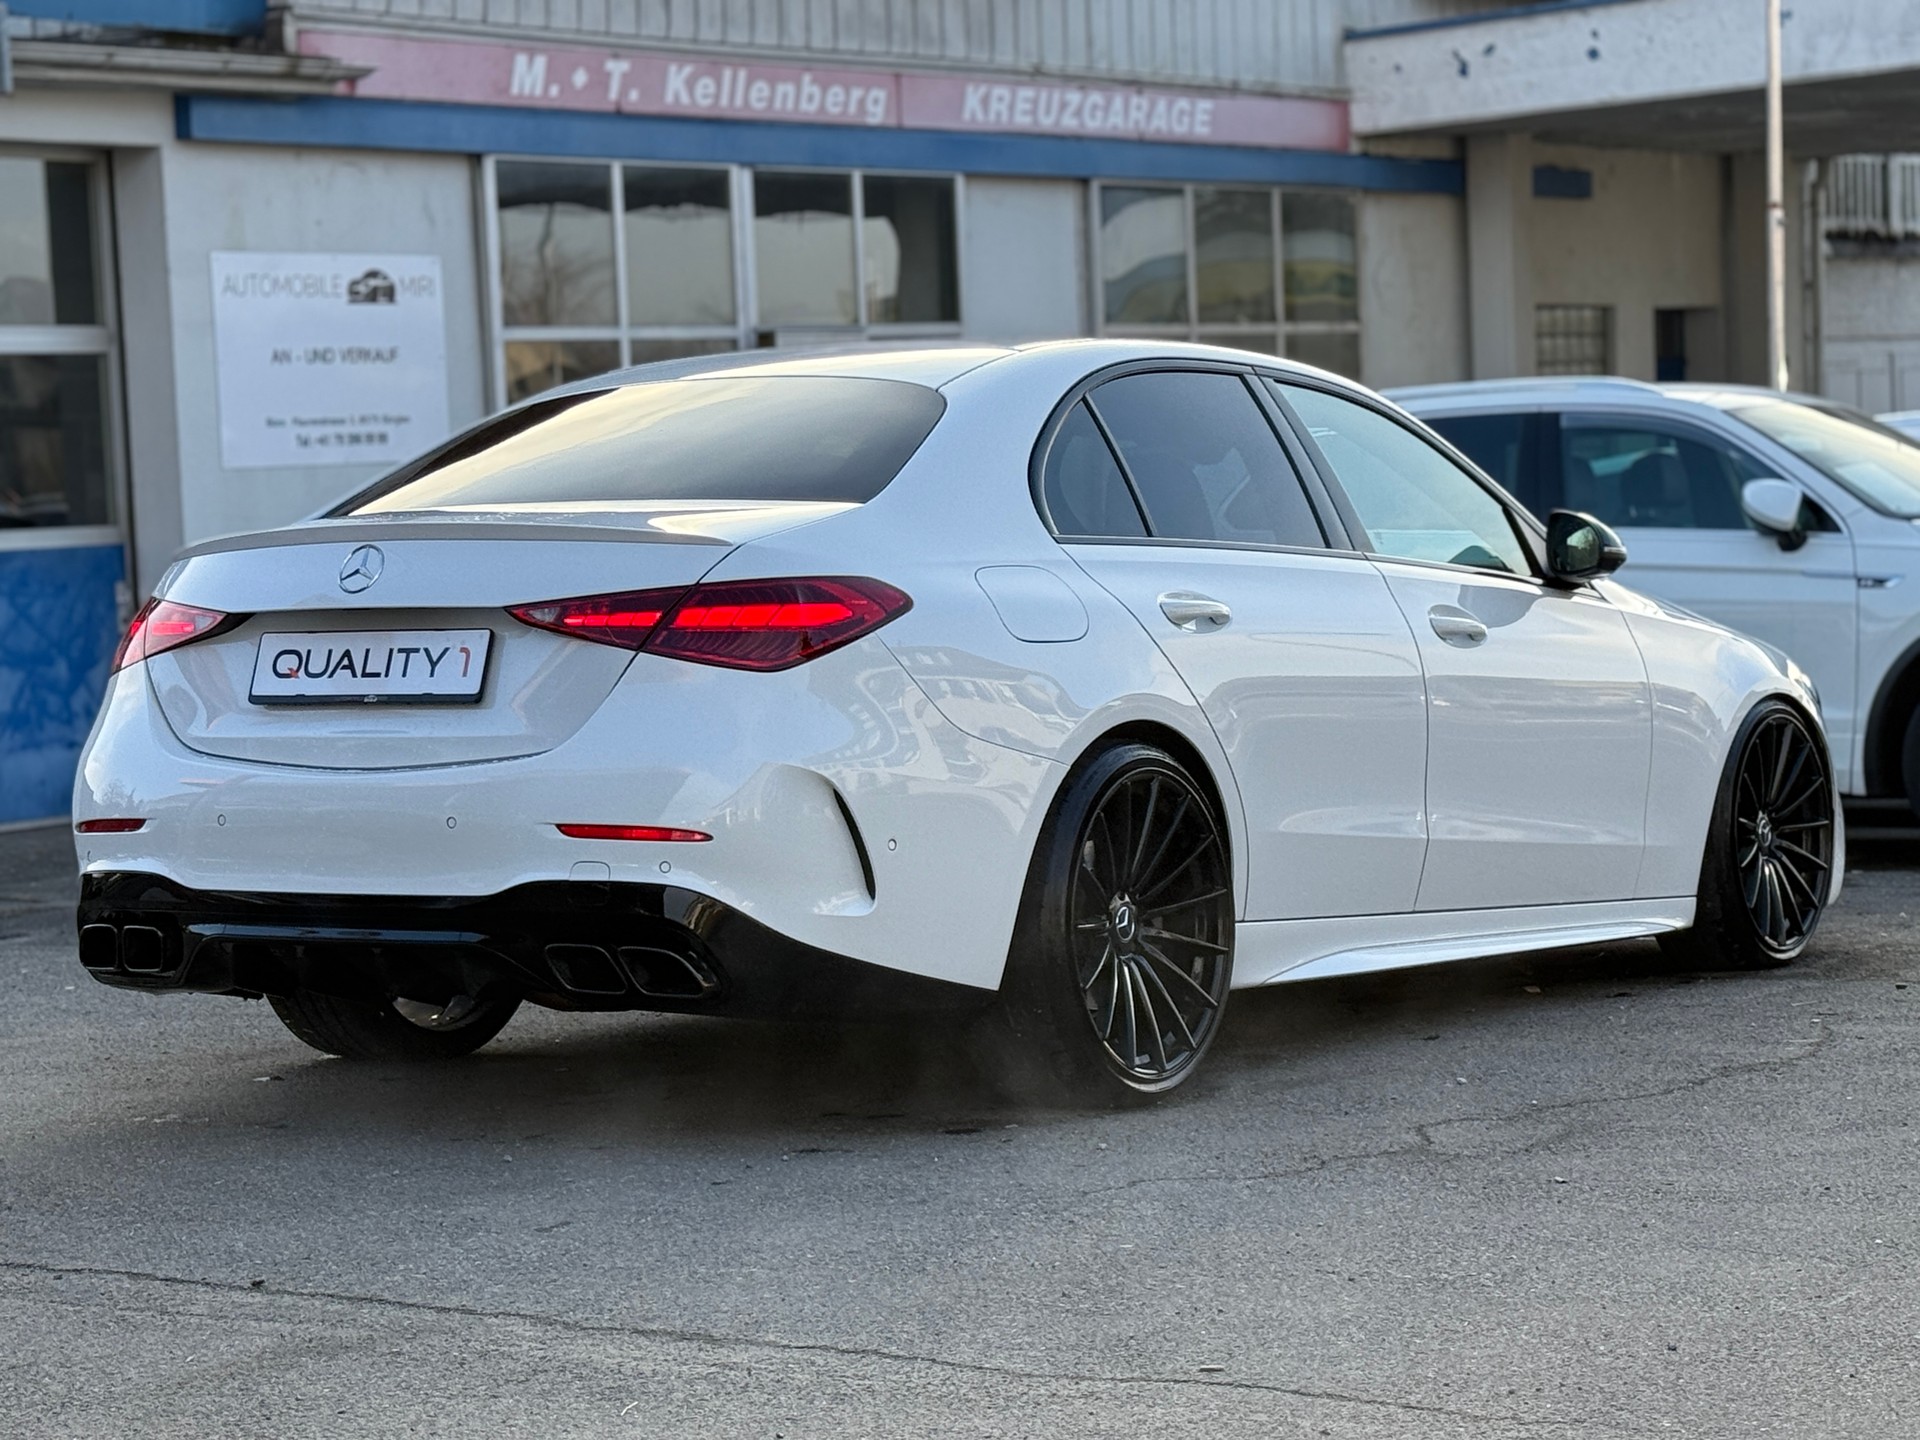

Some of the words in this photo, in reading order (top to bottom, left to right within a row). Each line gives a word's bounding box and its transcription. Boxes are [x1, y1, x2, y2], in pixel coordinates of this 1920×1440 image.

[510, 52, 560, 97] M.
[604, 60, 640, 101] T.
[664, 63, 888, 124] Kellenberg
[962, 82, 1214, 135] KREUZGARAGE
[221, 272, 343, 299] AUTOMOBILE
[303, 346, 337, 366] UND
[340, 345, 399, 365] VERKAUF
[272, 646, 450, 679] QUALITY
